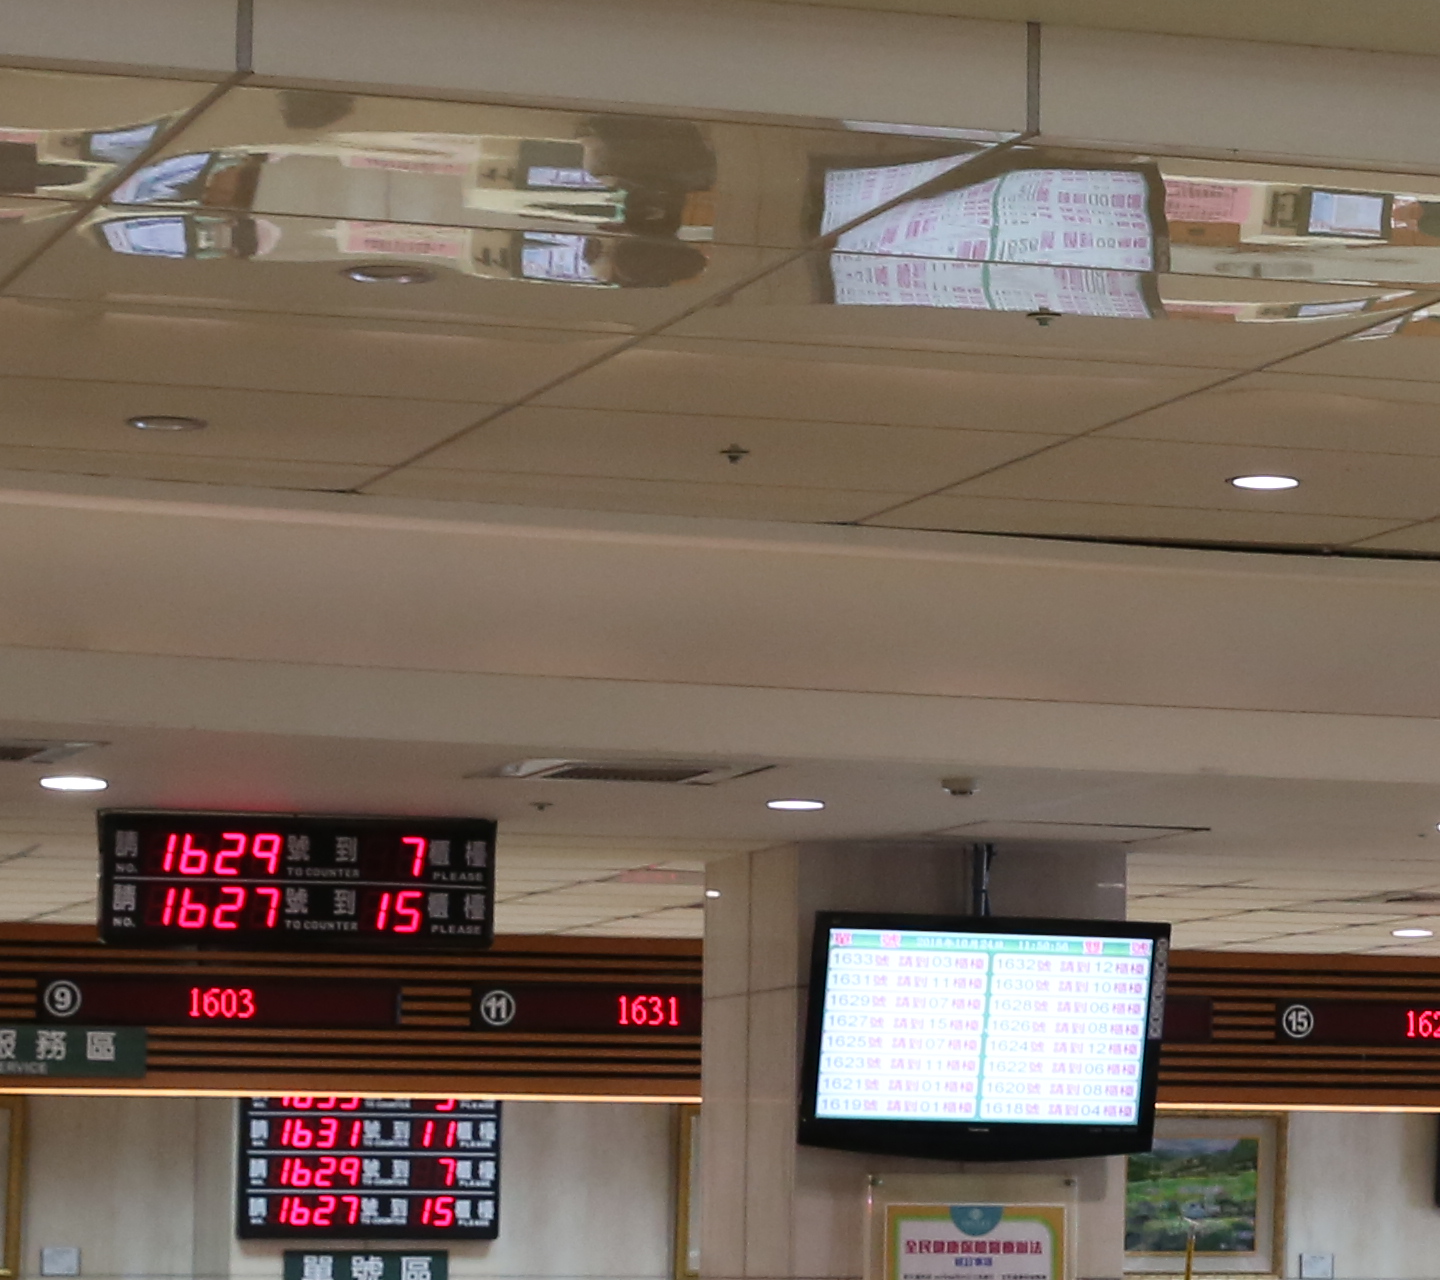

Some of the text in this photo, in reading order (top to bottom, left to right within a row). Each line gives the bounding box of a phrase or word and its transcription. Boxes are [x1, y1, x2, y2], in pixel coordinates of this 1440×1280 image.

[163, 832, 282, 875] 1629
[401, 836, 427, 878] 7
[304, 867, 360, 878] COUNTER
[432, 871, 483, 882] PLEASE
[161, 887, 281, 929] 1627
[376, 891, 424, 933] 15
[303, 920, 359, 931] COUNTER
[431, 924, 482, 935] PLEASE
[189, 987, 257, 1018] 1603
[618, 995, 679, 1026] 1631
[281, 1118, 362, 1148] 1631
[422, 1120, 457, 1148] 11
[280, 1157, 360, 1187] 1629
[438, 1158, 456, 1186] 7
[279, 1195, 359, 1225] 1627
[421, 1196, 455, 1226] 15
